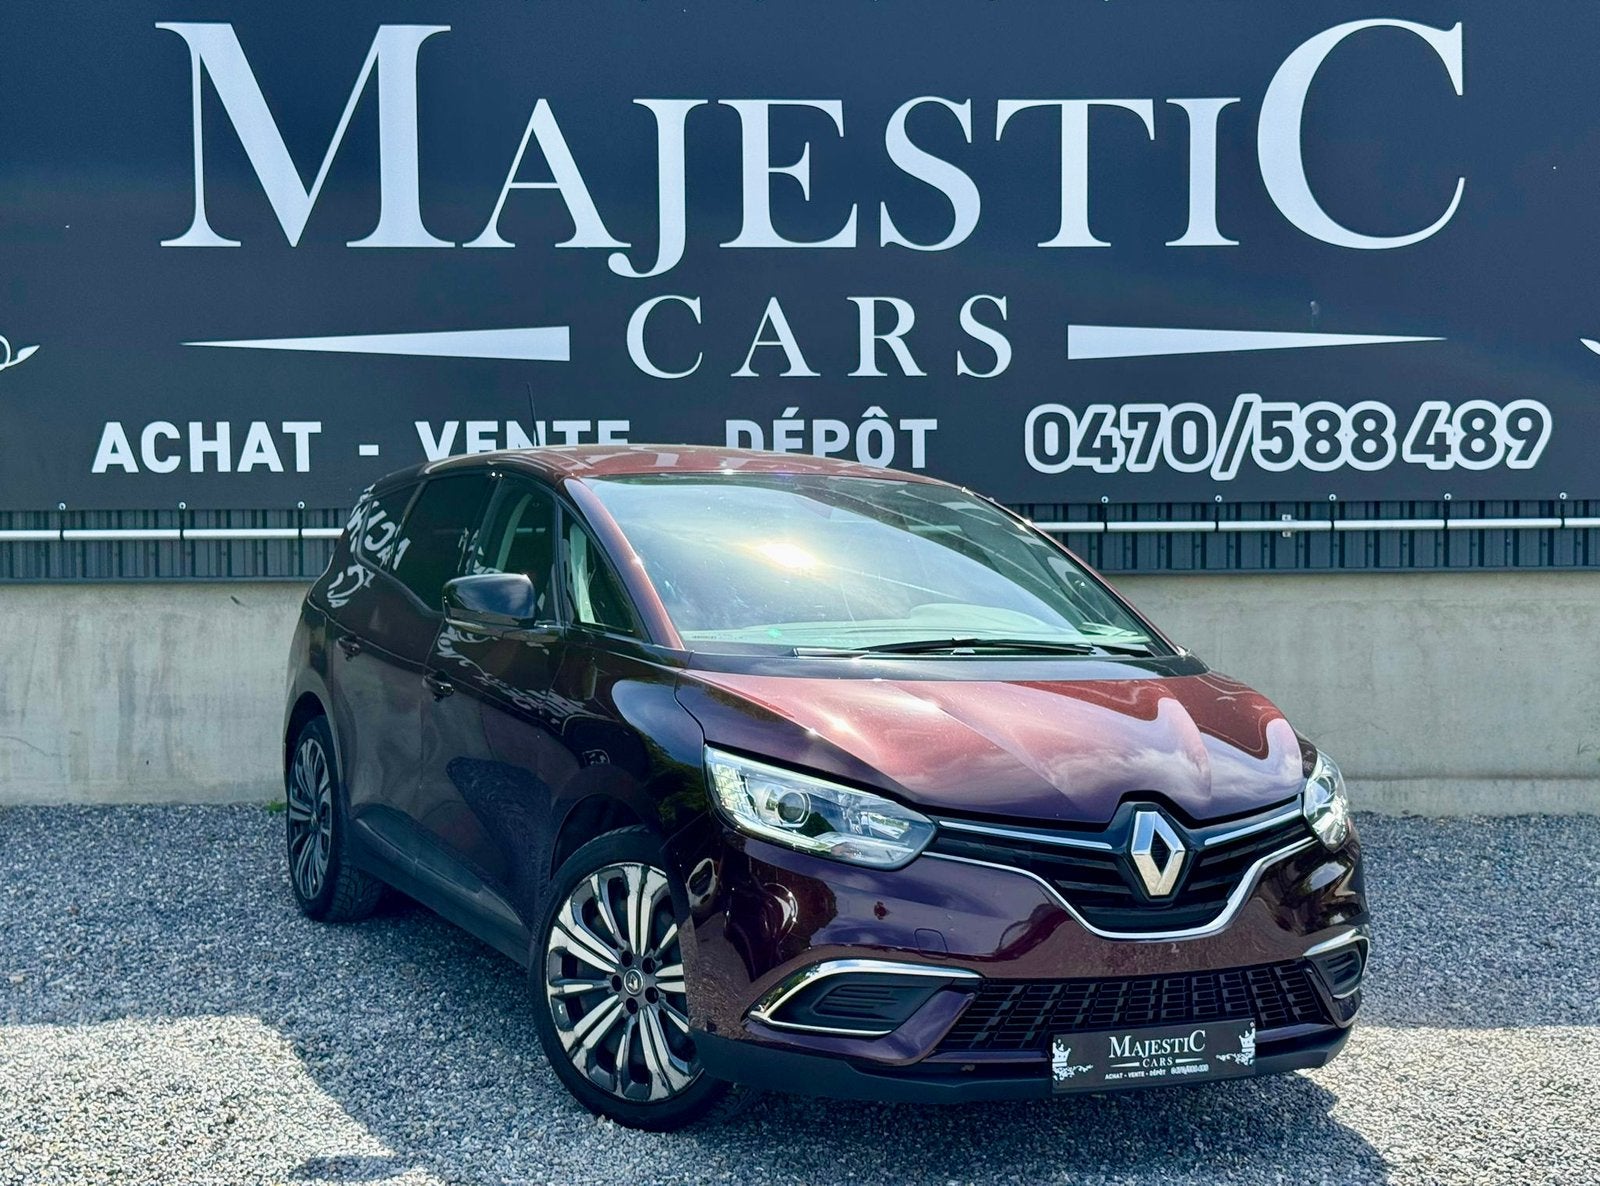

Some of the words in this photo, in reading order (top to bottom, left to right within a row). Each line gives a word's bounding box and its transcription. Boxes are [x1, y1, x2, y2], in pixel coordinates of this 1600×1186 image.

[155, 19, 1465, 277] MAJESTIC
[627, 295, 1011, 378] CARS
[92, 421, 321, 473] ACHAT
[726, 406, 937, 468] DÉPÔT
[1108, 1029, 1206, 1058] MAJESTIC
[1142, 1056, 1173, 1068] CARS
